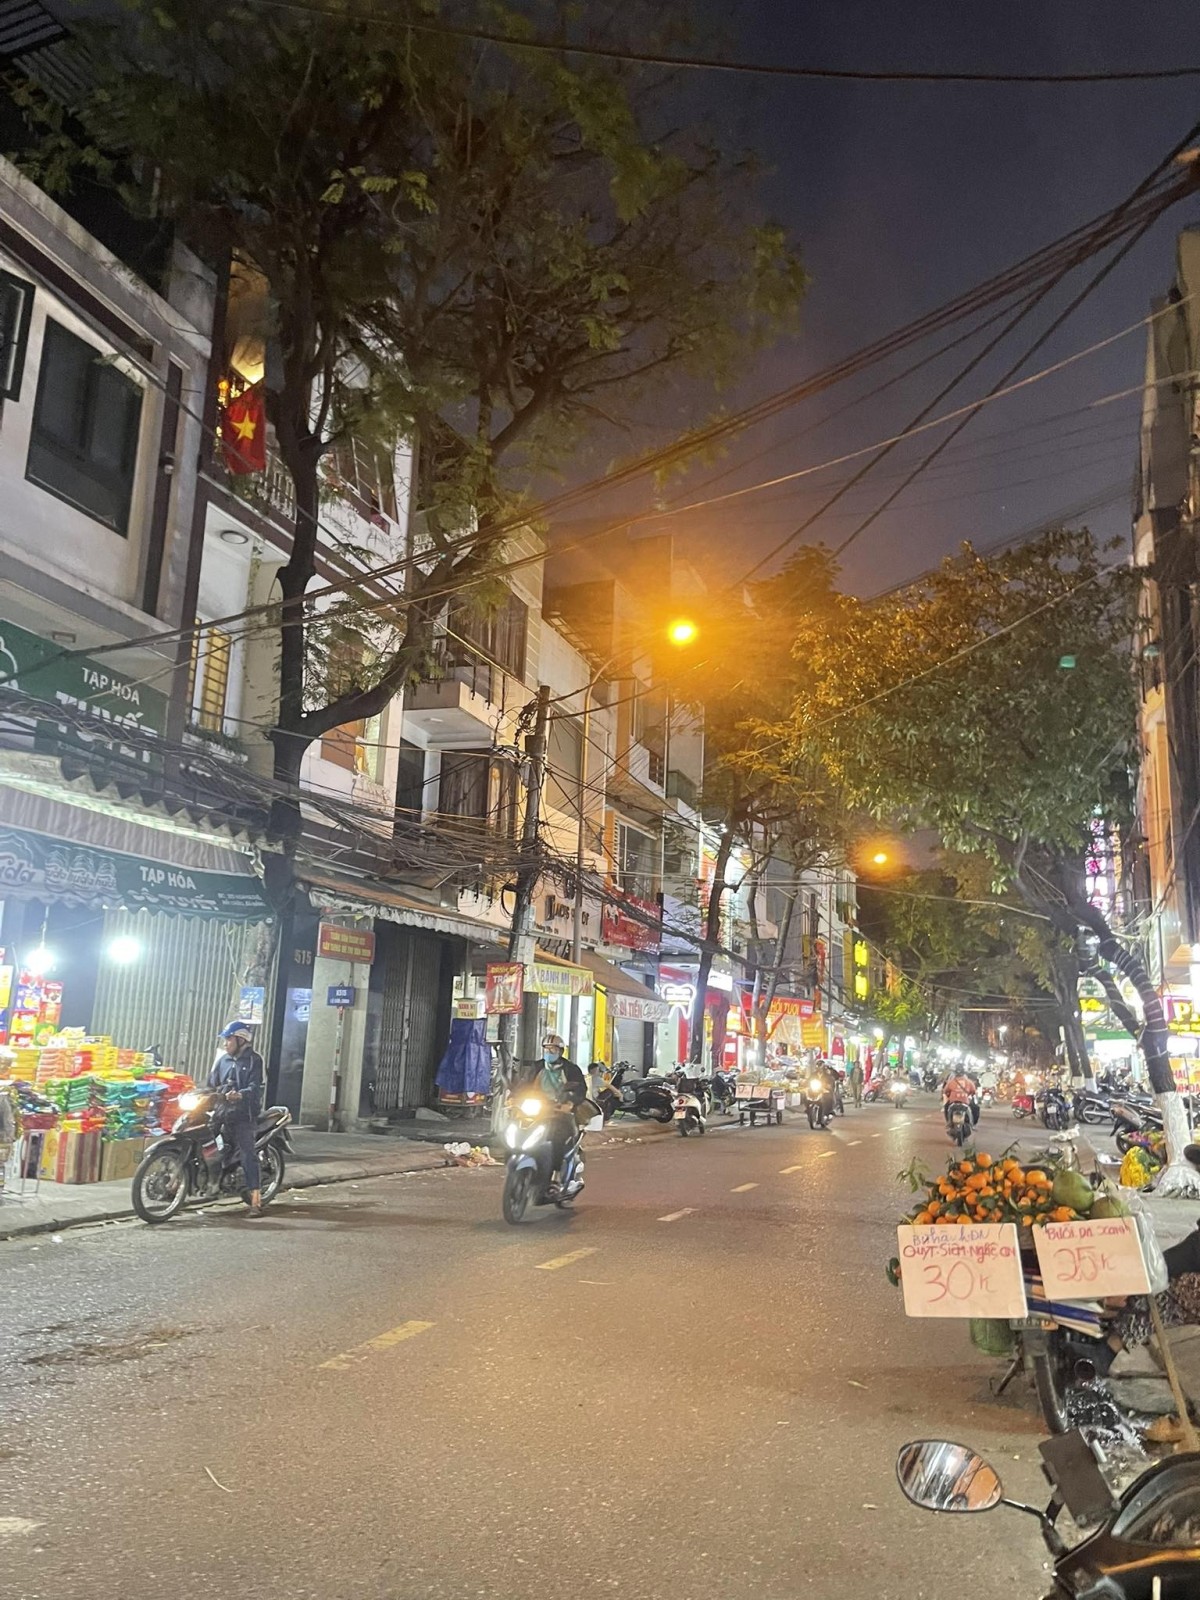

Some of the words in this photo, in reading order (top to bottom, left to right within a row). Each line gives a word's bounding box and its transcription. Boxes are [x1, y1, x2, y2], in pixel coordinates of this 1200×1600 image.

[82, 667, 108, 690] TẠP
[140, 866, 165, 887] TẠP
[168, 871, 197, 890] HÓA
[294, 949, 312, 965] 515
